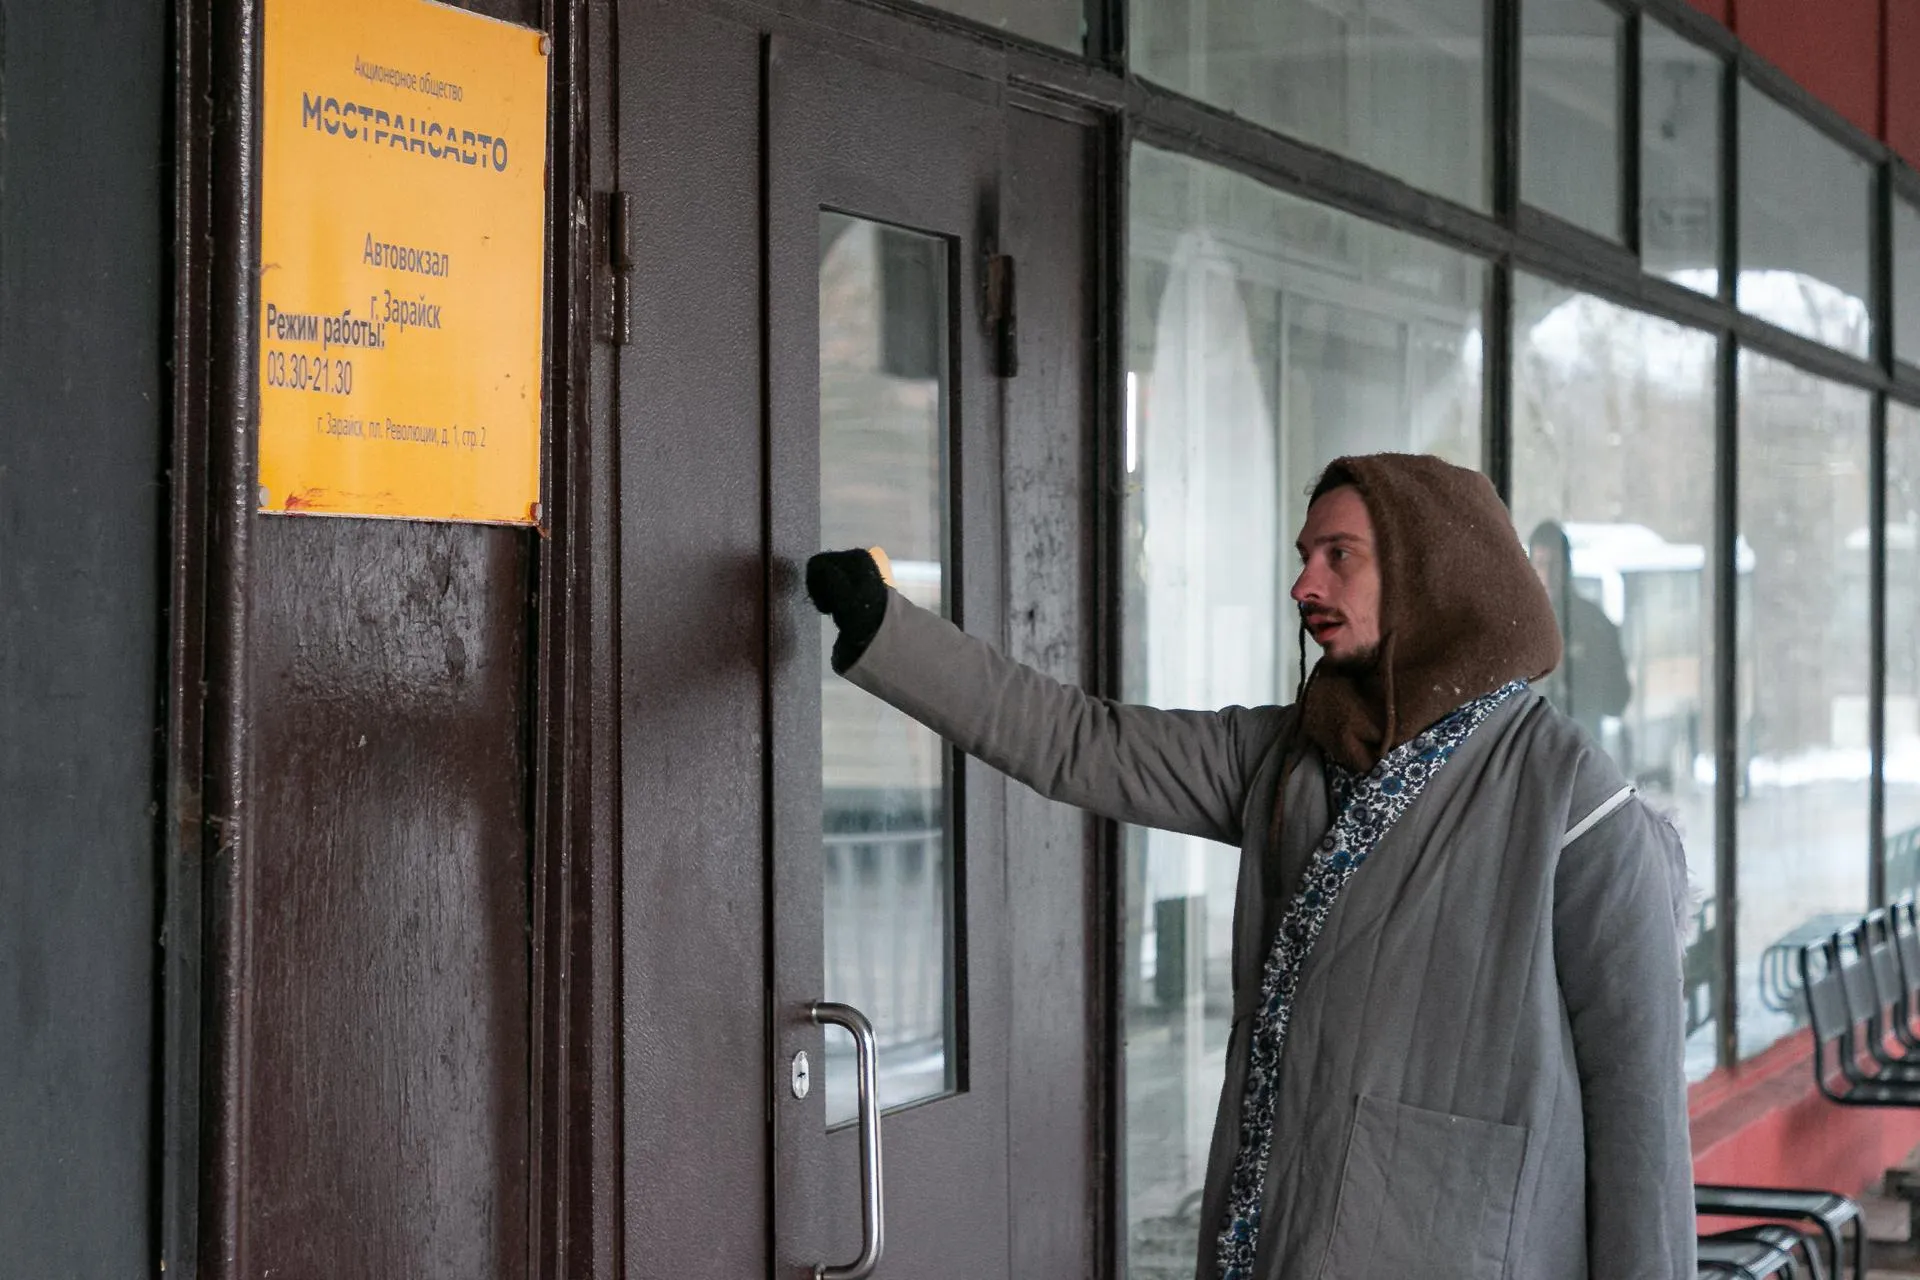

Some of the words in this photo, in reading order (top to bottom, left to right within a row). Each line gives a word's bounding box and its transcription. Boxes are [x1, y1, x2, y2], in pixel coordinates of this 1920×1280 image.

[354, 54, 417, 92] Акционерное
[419, 72, 463, 102] общество
[302, 91, 508, 172] МОСТРАНСАВТО
[363, 232, 449, 277] Автовокзал
[267, 303, 318, 341] Режим
[323, 309, 385, 351] работы:
[370, 296, 379, 320] г.
[383, 289, 442, 333] Зарайск
[267, 350, 353, 395] 03.30-21.30
[326, 412, 365, 440] Зарайск,
[368, 421, 383, 439] пл.
[386, 418, 439, 447] Революции,
[481, 427, 486, 447] 2
